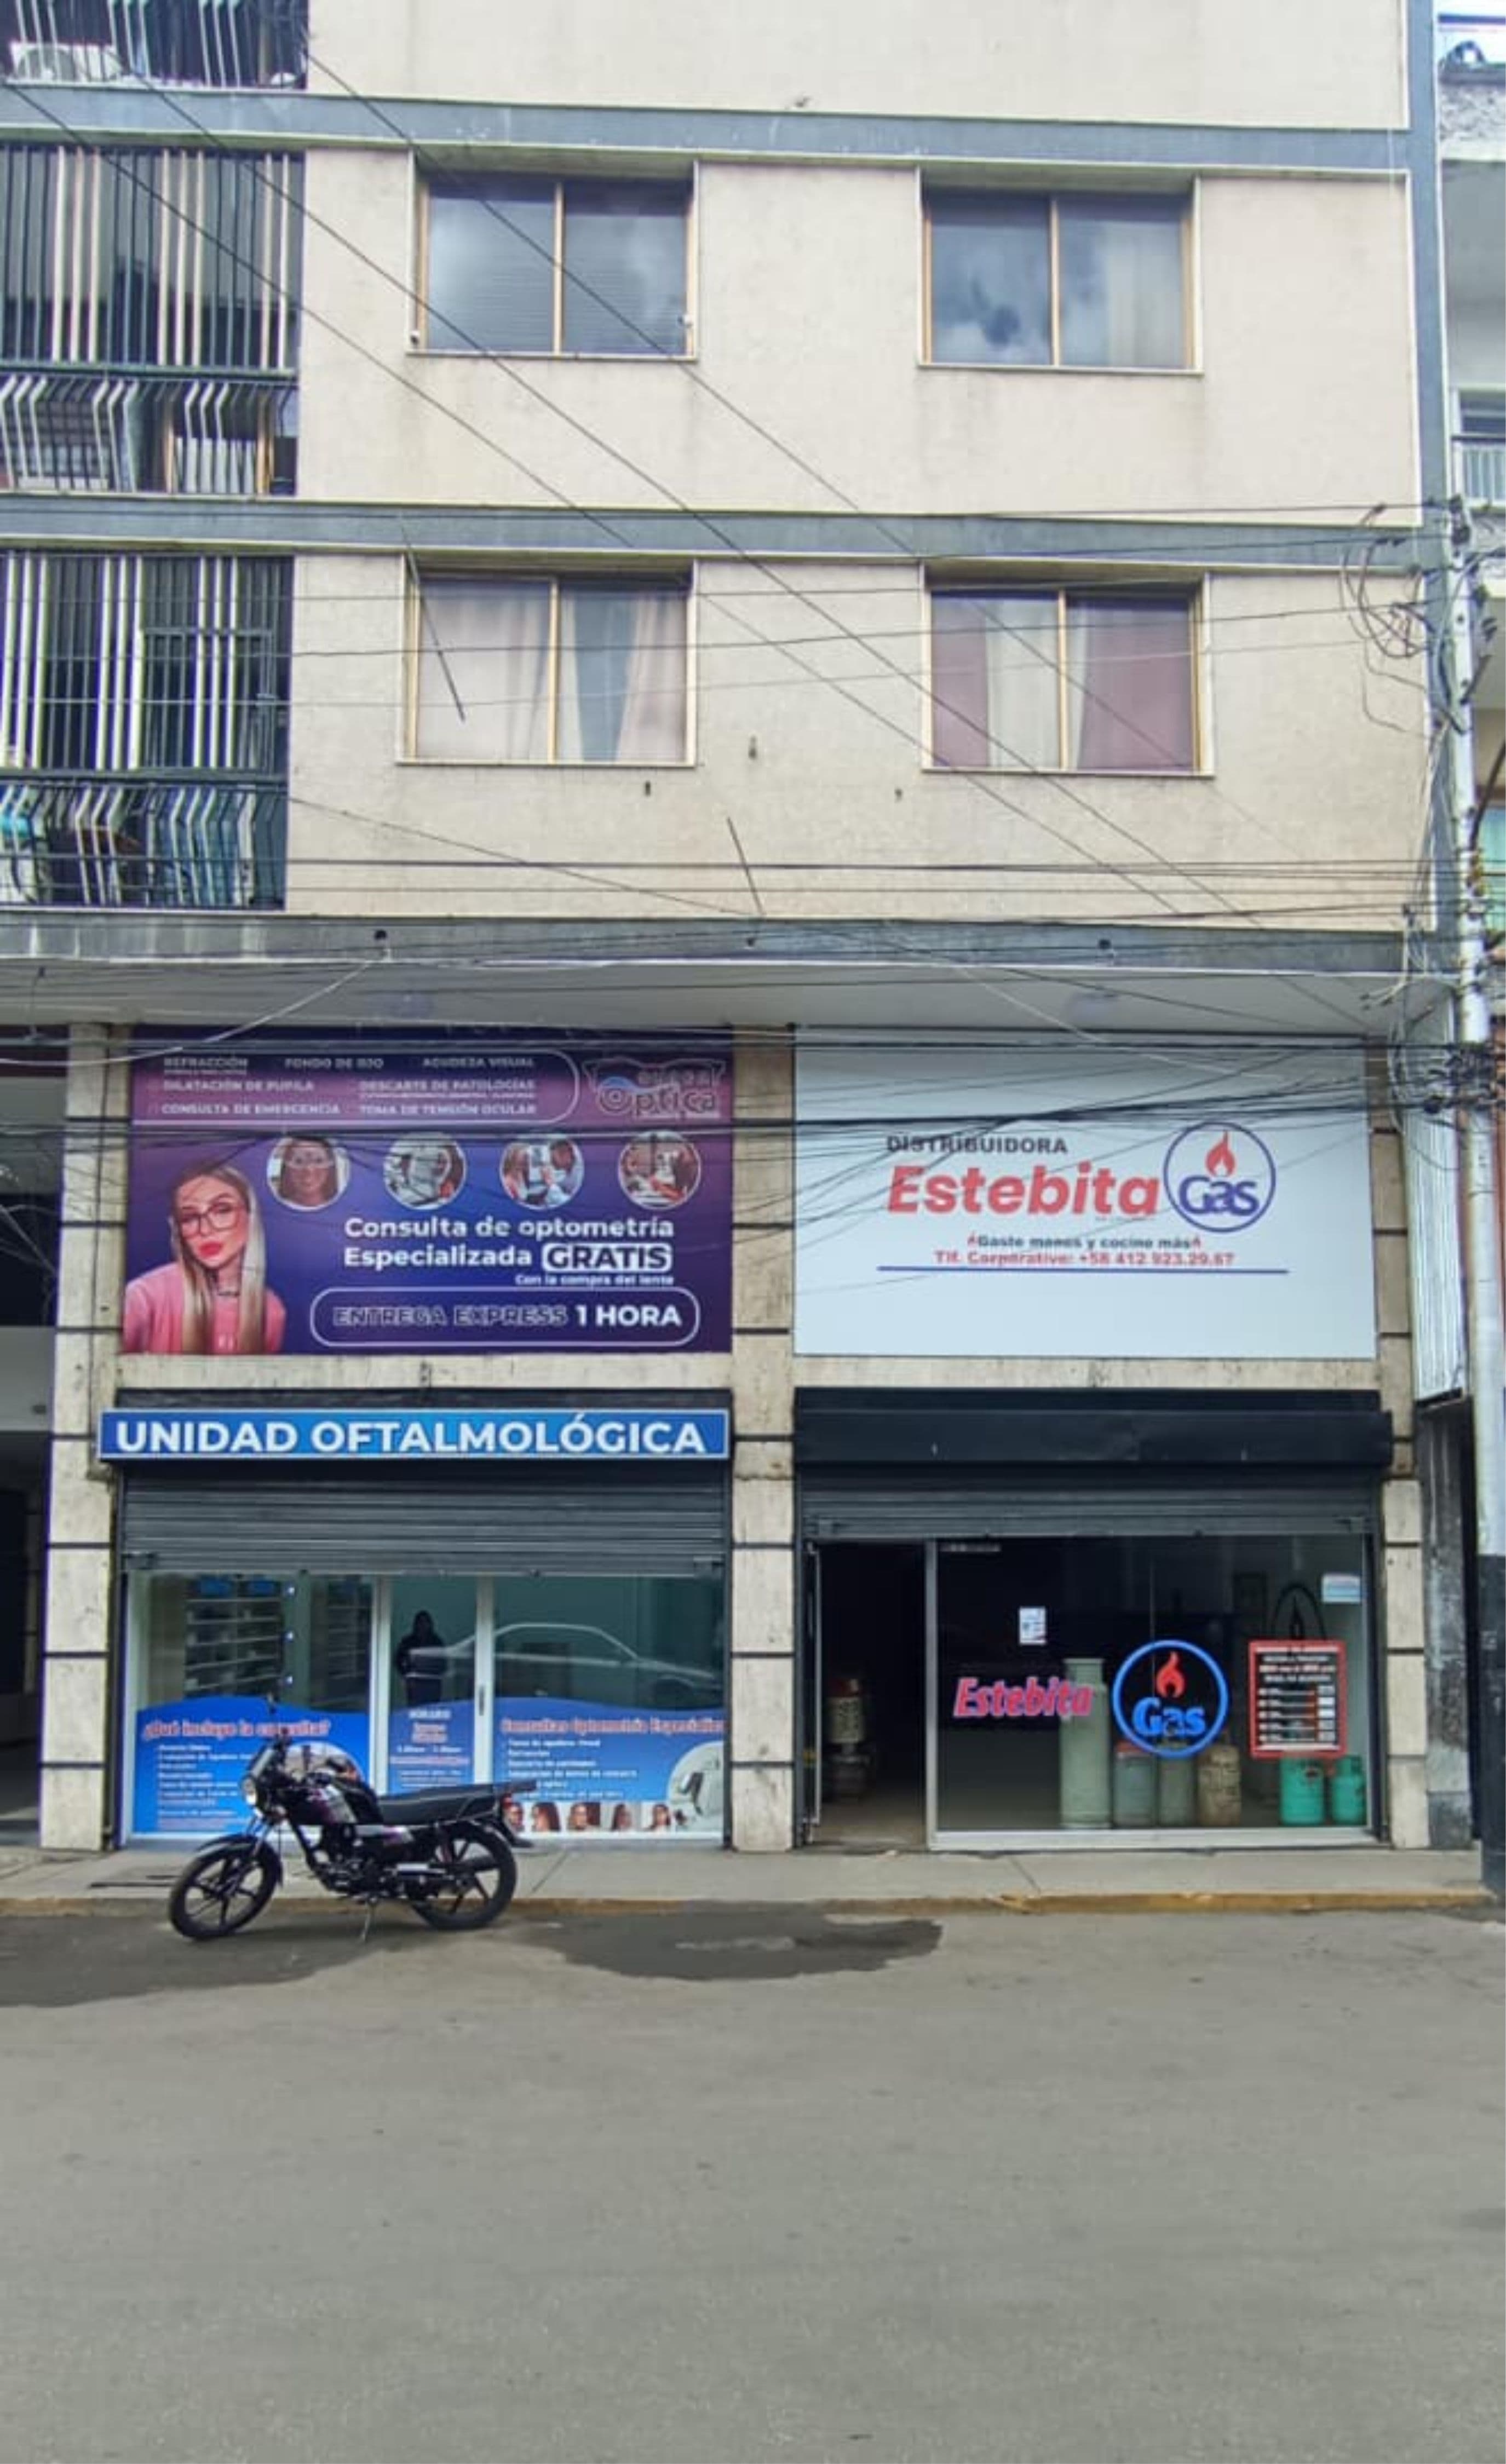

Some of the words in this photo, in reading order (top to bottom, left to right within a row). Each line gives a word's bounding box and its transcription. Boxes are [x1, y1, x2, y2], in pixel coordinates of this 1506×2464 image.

[284, 1058, 332, 1068] FONDO
[335, 1058, 352, 1068] DE
[246, 1080, 263, 1091] DE
[431, 1080, 449, 1091] DE
[162, 1104, 230, 1114] CONSULTA
[234, 1104, 250, 1114] DE
[254, 1104, 341, 1114] EMERGENCIA
[360, 1104, 397, 1114] TOMA
[401, 1104, 418, 1114] DE
[481, 1104, 537, 1114] OCULAR
[886, 1136, 1068, 1155] DISTRIBUIDORA
[887, 1160, 1160, 1216] Estebita
[1179, 1175, 1258, 1217] Gas
[344, 1216, 467, 1238] Consulta
[475, 1216, 509, 1238] de
[518, 1216, 675, 1241] optometría
[1087, 1238, 1095, 1251] y
[344, 1244, 532, 1270] Especializada
[546, 1246, 669, 1269] GRATIS
[1116, 1252, 1146, 1265] 412
[515, 1274, 542, 1286] Con
[546, 1274, 557, 1286] la
[560, 1275, 611, 1288] compra
[614, 1274, 636, 1286] del
[639, 1274, 675, 1286] lente
[333, 1306, 447, 1326] ENTREGA
[454, 1306, 568, 1326] EXPRESS
[574, 1305, 587, 1326] 1
[595, 1305, 683, 1326] HORA
[116, 1421, 298, 1452] UNIDAD
[311, 1413, 706, 1453] OFTALMOLÓGICA
[953, 1676, 1094, 1718] Estebita
[1132, 1696, 1206, 1738] Gas
